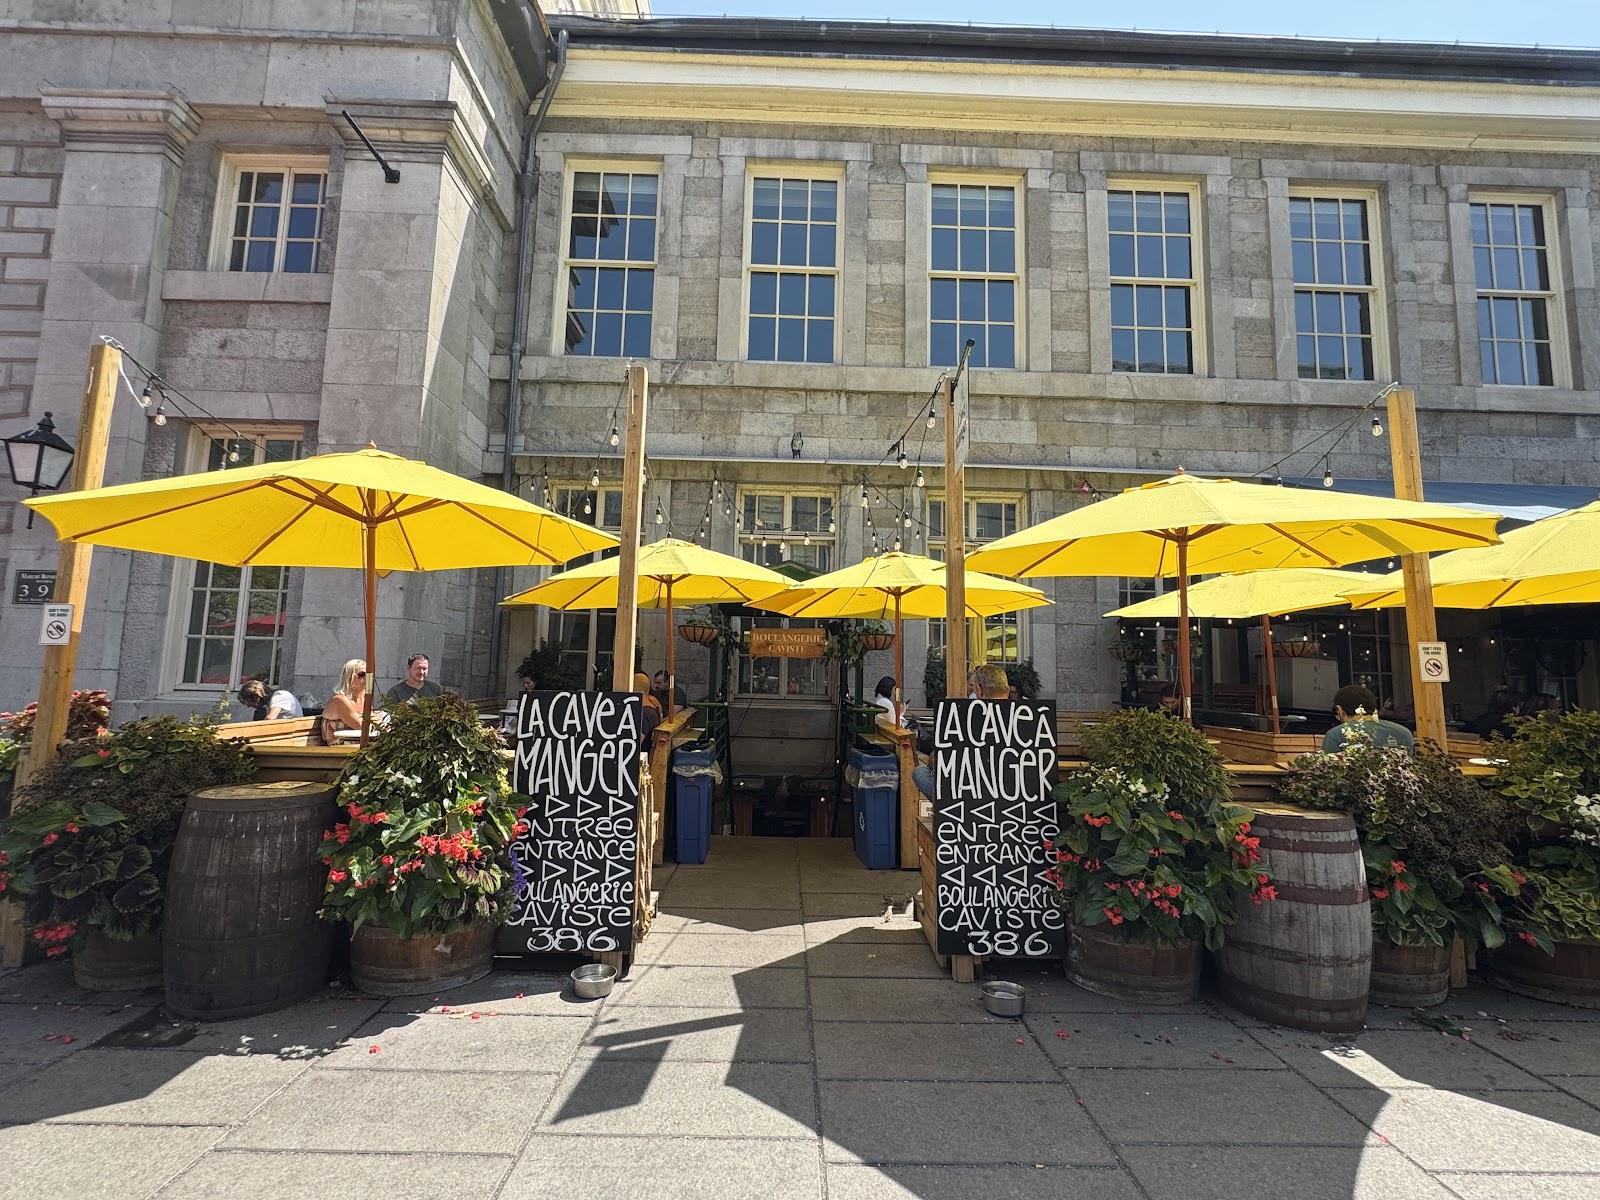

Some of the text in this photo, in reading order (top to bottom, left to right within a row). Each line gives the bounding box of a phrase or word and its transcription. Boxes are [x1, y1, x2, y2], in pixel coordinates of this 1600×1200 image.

[768, 644, 806, 653] CAVISTE
[517, 694, 545, 739] LA
[935, 701, 964, 748] LA
[527, 926, 620, 952] 386
[967, 929, 1052, 956] 386
